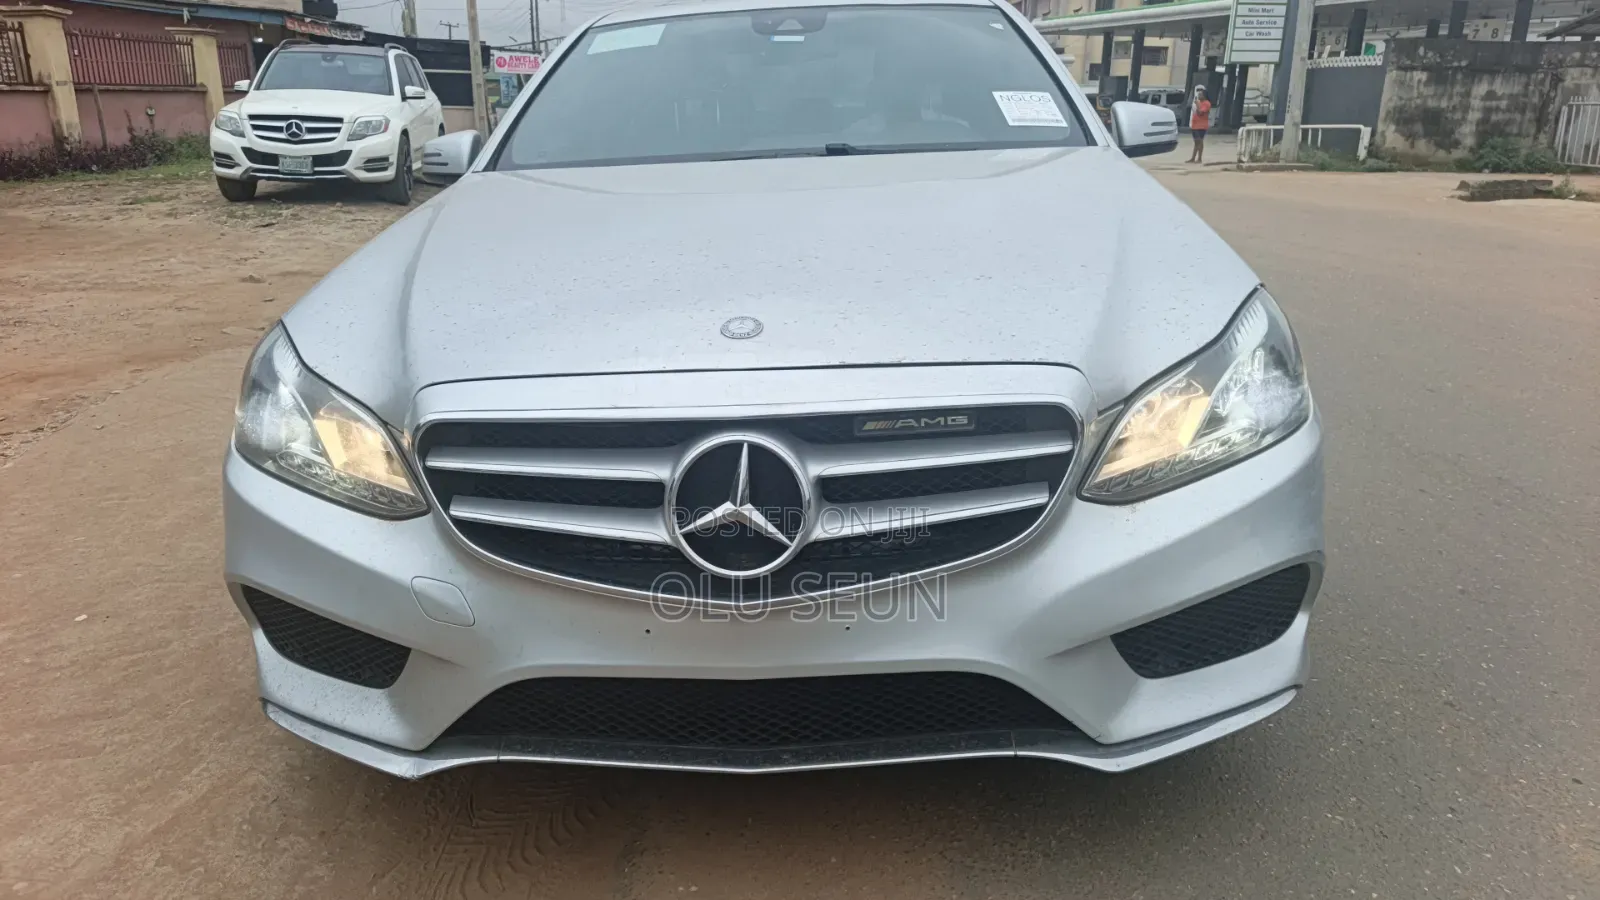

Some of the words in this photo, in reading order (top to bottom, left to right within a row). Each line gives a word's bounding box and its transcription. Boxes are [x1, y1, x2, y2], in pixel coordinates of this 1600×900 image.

[1472, 28, 1480, 39] 7
[1491, 27, 1499, 39] 8
[509, 55, 539, 63] AWELE
[895, 415, 968, 428] AMG
